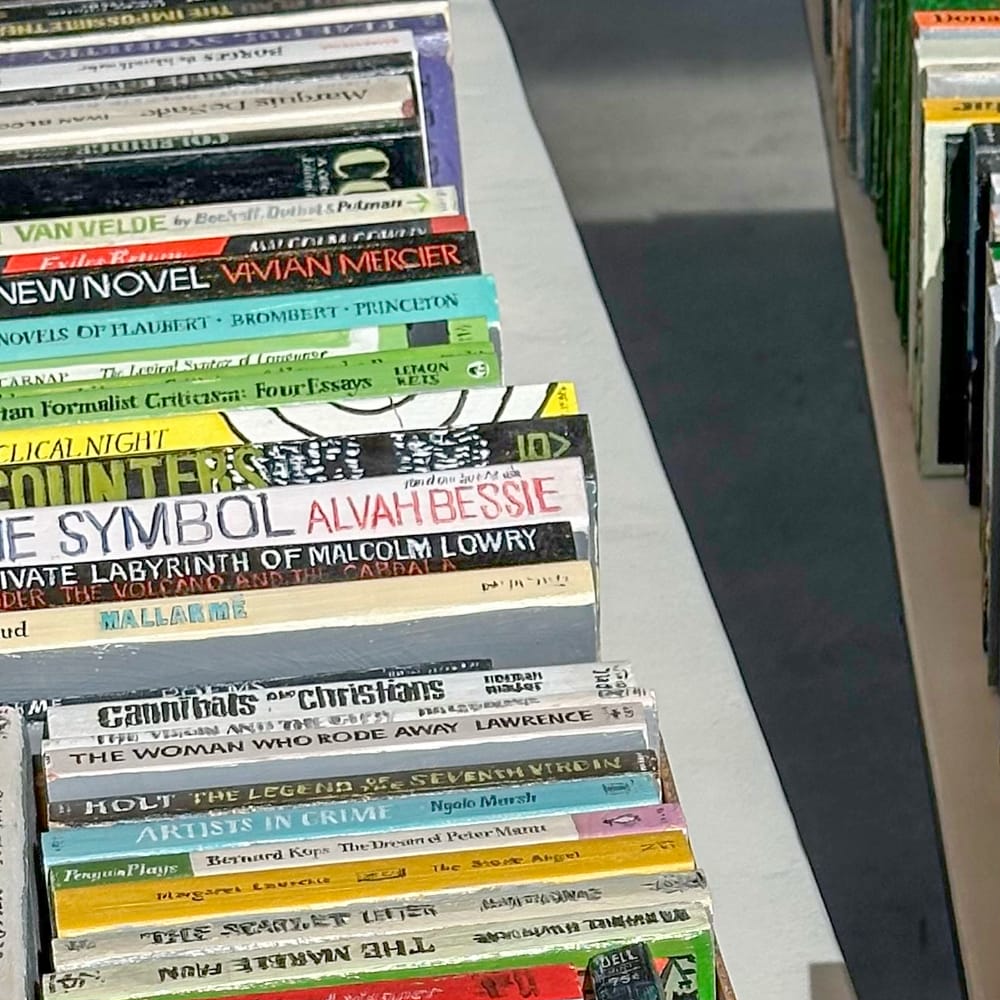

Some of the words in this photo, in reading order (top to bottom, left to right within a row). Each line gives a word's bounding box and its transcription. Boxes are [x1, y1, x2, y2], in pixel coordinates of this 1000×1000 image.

[14, 222, 74, 243] VAN
[75, 213, 168, 238] VELDE
[82, 264, 211, 301] NOVEL
[339, 242, 462, 276] MERCIER
[76, 320, 106, 341] OF
[112, 315, 210, 339] FLAUBERT
[230, 303, 338, 328] BROMBERT
[254, 379, 308, 400] Four
[306, 373, 374, 399] Essays
[85, 427, 170, 457] NIGHT
[58, 492, 296, 556] SYMBOL
[306, 486, 425, 535] ALVAH
[428, 475, 564, 526] BESSIE
[90, 549, 250, 585] LABYRINTH
[260, 546, 304, 571] OF
[308, 535, 433, 567] MALCOLM
[441, 526, 538, 560] LOWRY
[60, 584, 103, 604] THE
[69, 748, 126, 766] THE
[131, 737, 247, 761] WOMAN
[251, 734, 315, 752] WHO
[317, 727, 389, 748] RODE
[394, 722, 460, 740] AWAY
[475, 709, 595, 732] LAWRENCE
[191, 788, 240, 806] THE
[135, 816, 254, 845] ARTISTS
[263, 810, 291, 832] IN
[301, 802, 393, 828] CRIME
[359, 936, 437, 961] THE
[600, 948, 640, 969] DELL
